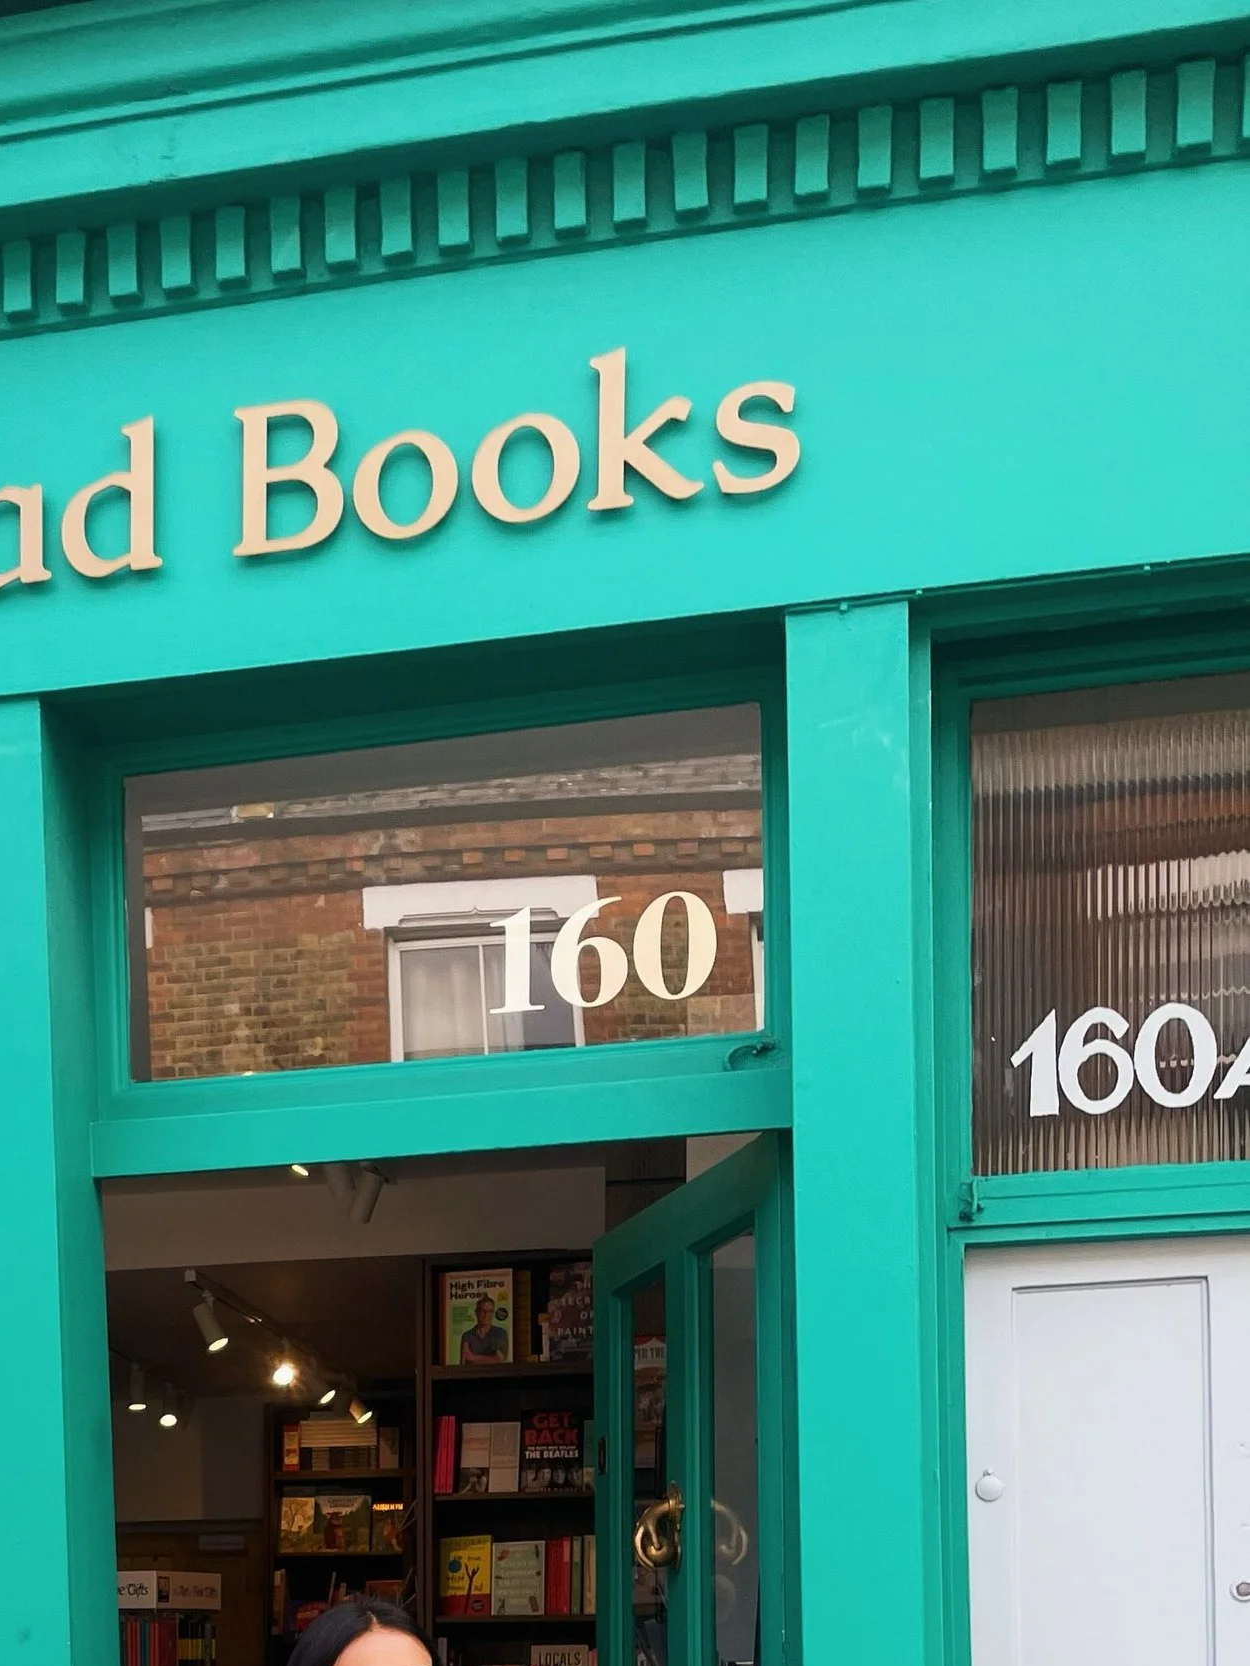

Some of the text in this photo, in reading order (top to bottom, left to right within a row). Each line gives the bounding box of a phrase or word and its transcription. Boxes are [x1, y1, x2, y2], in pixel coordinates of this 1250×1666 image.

[233, 344, 804, 562] Books
[488, 890, 718, 1014] 160
[450, 1280, 505, 1291] High Fibre
[450, 1291, 488, 1300] Heroes
[532, 1411, 574, 1429] GET
[525, 1428, 579, 1446] BACK
[525, 1449, 579, 1460] THE BEATLES
[539, 1652, 582, 1666] LOCALS
